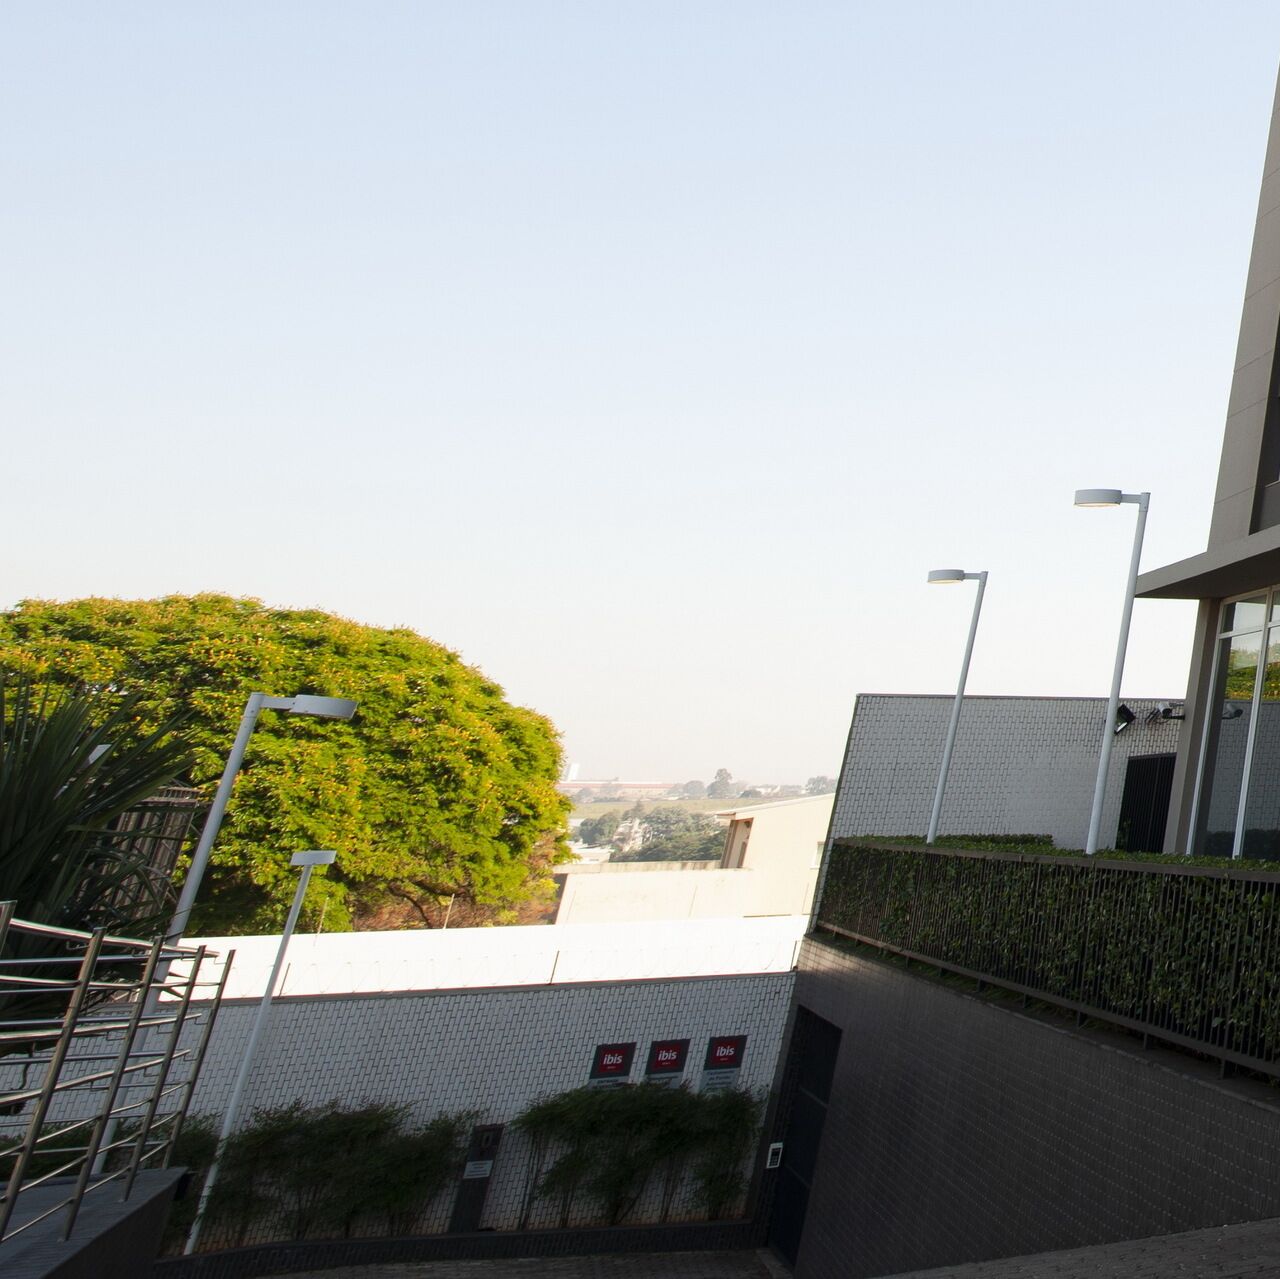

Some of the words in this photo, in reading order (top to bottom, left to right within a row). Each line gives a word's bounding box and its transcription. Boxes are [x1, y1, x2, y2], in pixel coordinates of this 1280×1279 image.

[658, 1049, 678, 1061] ibis
[716, 1045, 736, 1057] ibis
[603, 1053, 623, 1065] ibis
